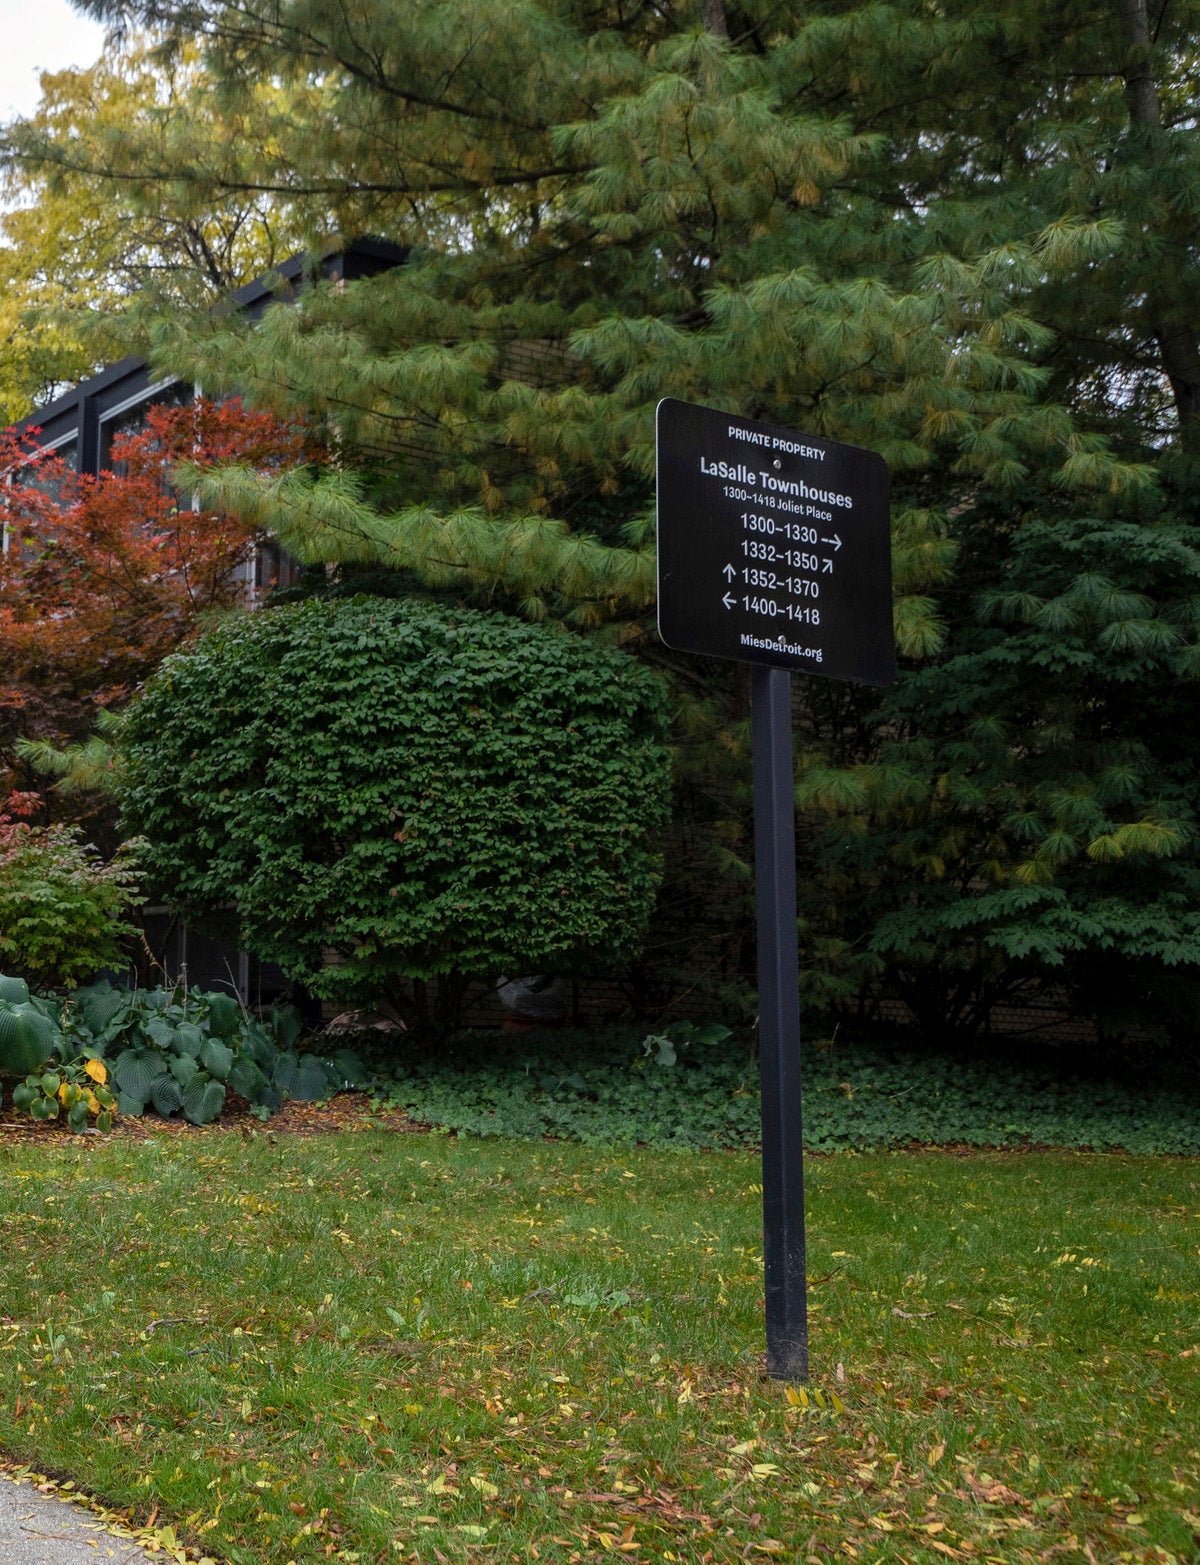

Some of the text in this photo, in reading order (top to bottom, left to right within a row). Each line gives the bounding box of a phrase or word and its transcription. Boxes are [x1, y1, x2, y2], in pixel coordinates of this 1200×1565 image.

[728, 426, 825, 461] PRIVATE PROPERTY
[700, 456, 853, 509] LaSalle Townhouses
[777, 498, 804, 516] Joliet
[806, 505, 833, 522] Place
[740, 633, 823, 663] MiesDetroit.org
